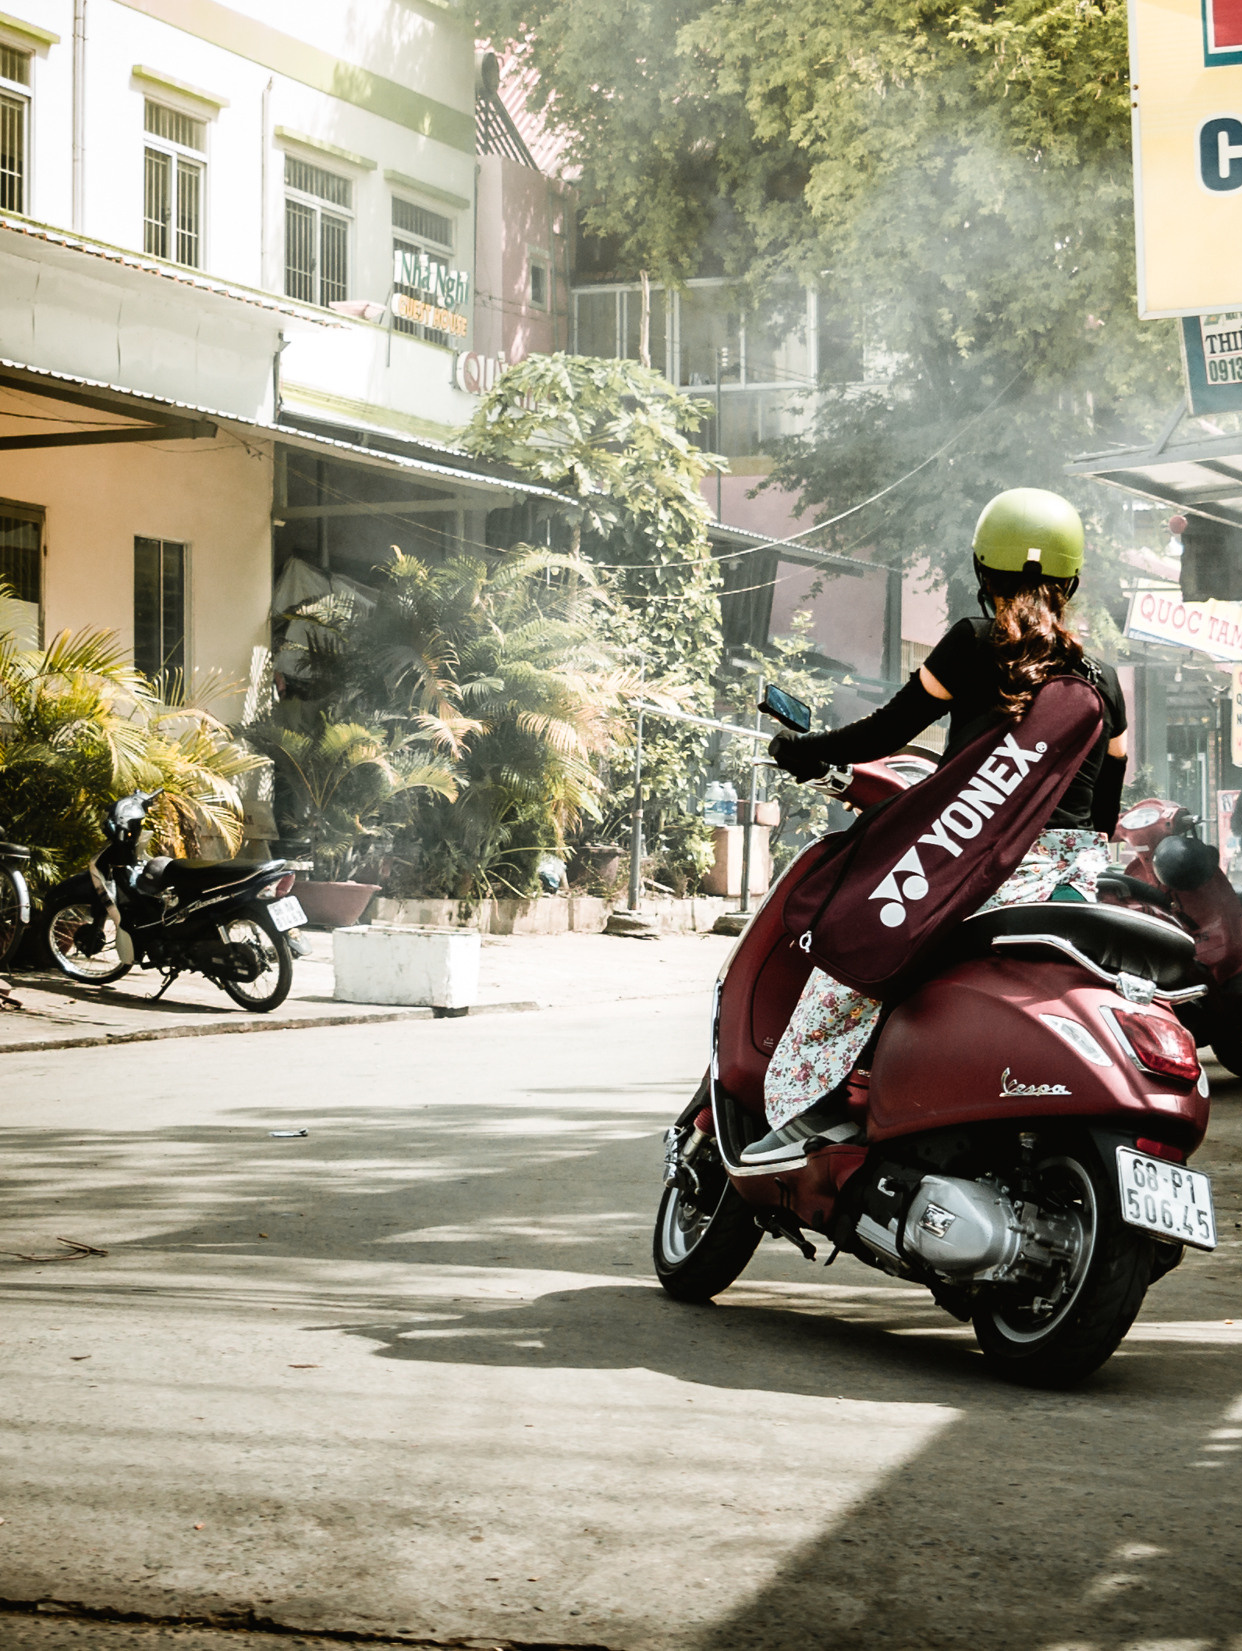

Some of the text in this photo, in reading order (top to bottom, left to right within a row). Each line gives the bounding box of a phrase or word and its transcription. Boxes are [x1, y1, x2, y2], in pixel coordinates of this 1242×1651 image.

[398, 294, 468, 337] GUEST HOUSE
[999, 1067, 1072, 1097] Vespa
[1127, 1187, 1210, 1240] 506.45
